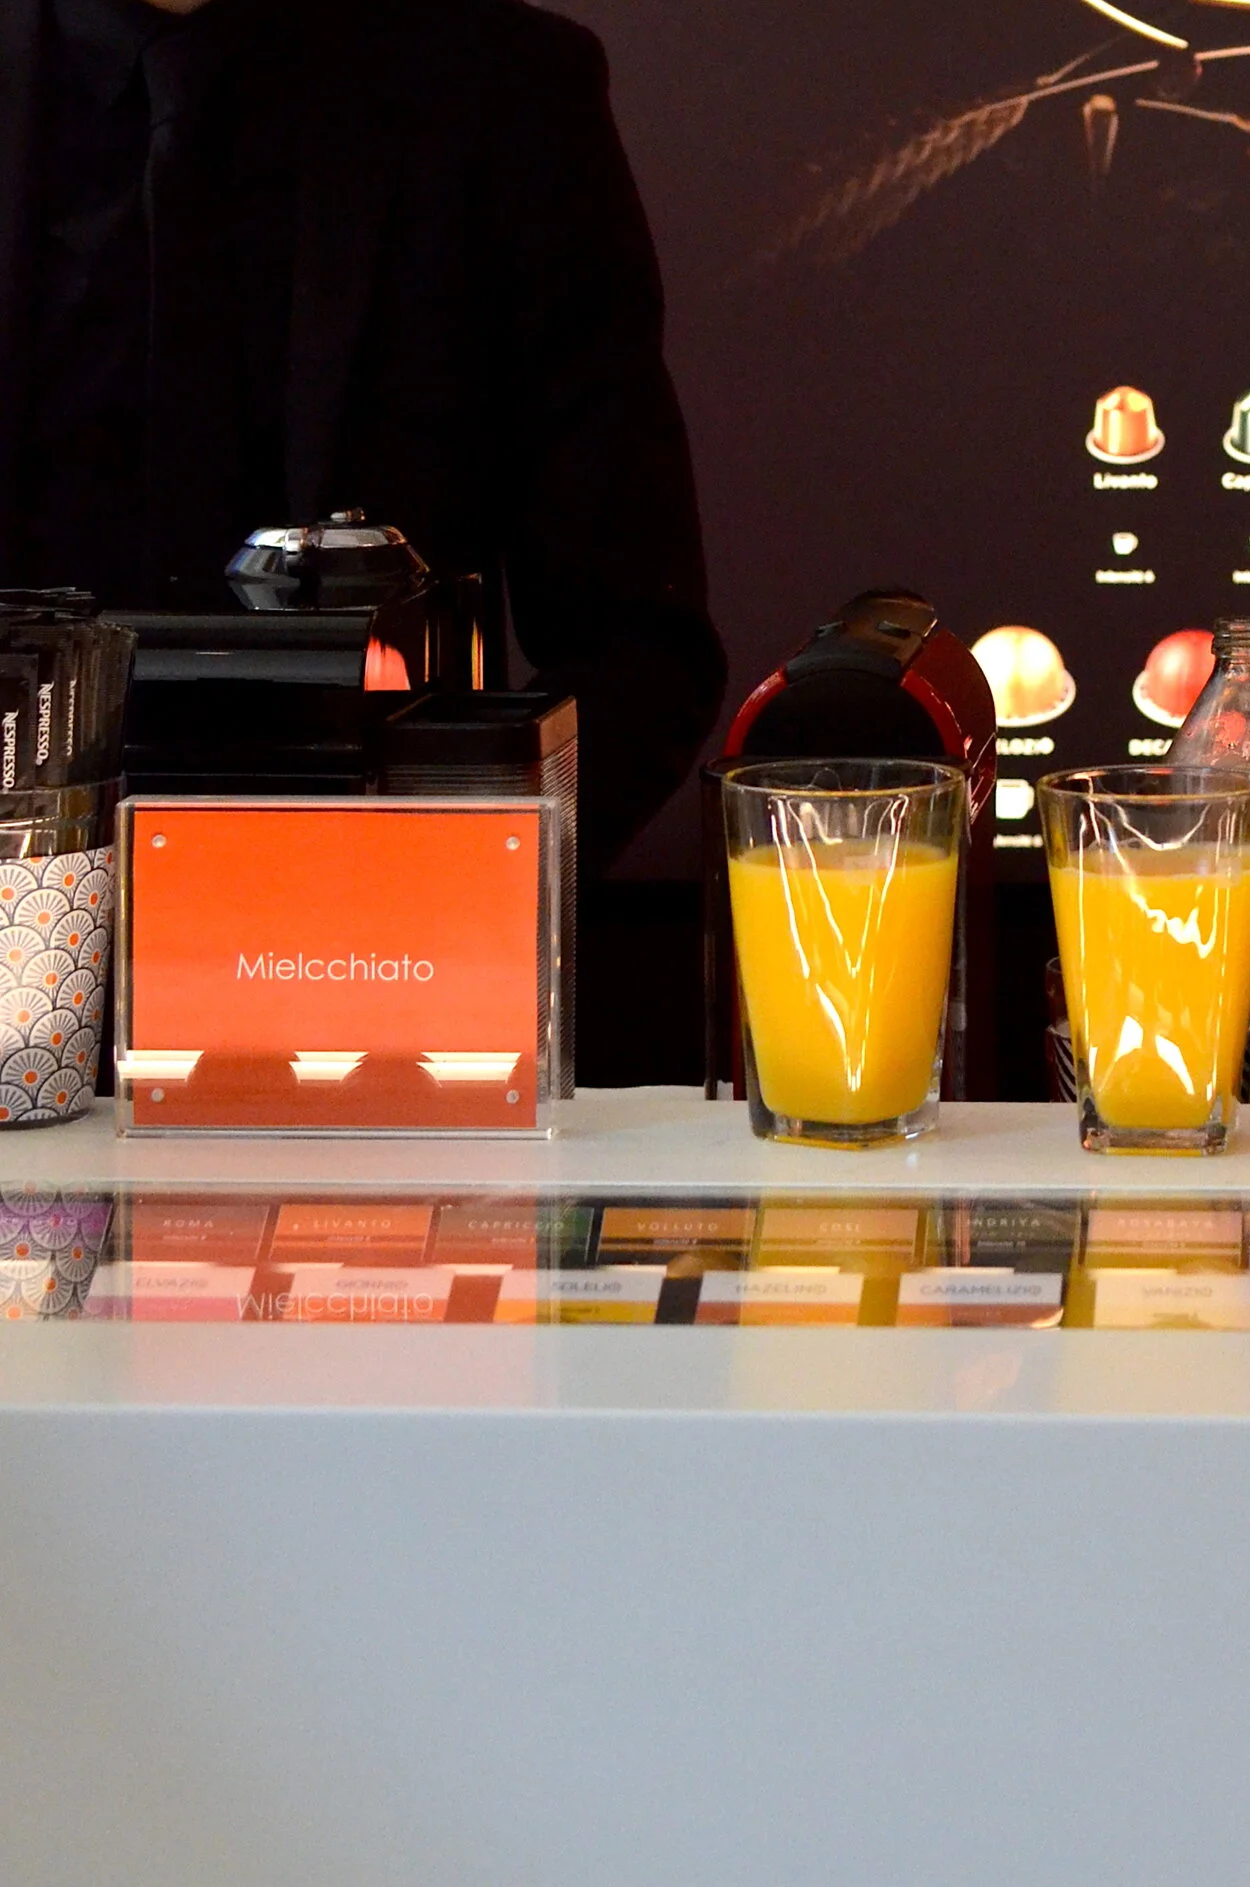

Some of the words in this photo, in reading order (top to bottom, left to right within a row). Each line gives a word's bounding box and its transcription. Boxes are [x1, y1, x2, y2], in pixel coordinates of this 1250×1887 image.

[2, 709, 19, 789] NESPRESSO
[36, 680, 55, 760] NESPRESSO
[236, 951, 435, 982] Mielcchiato
